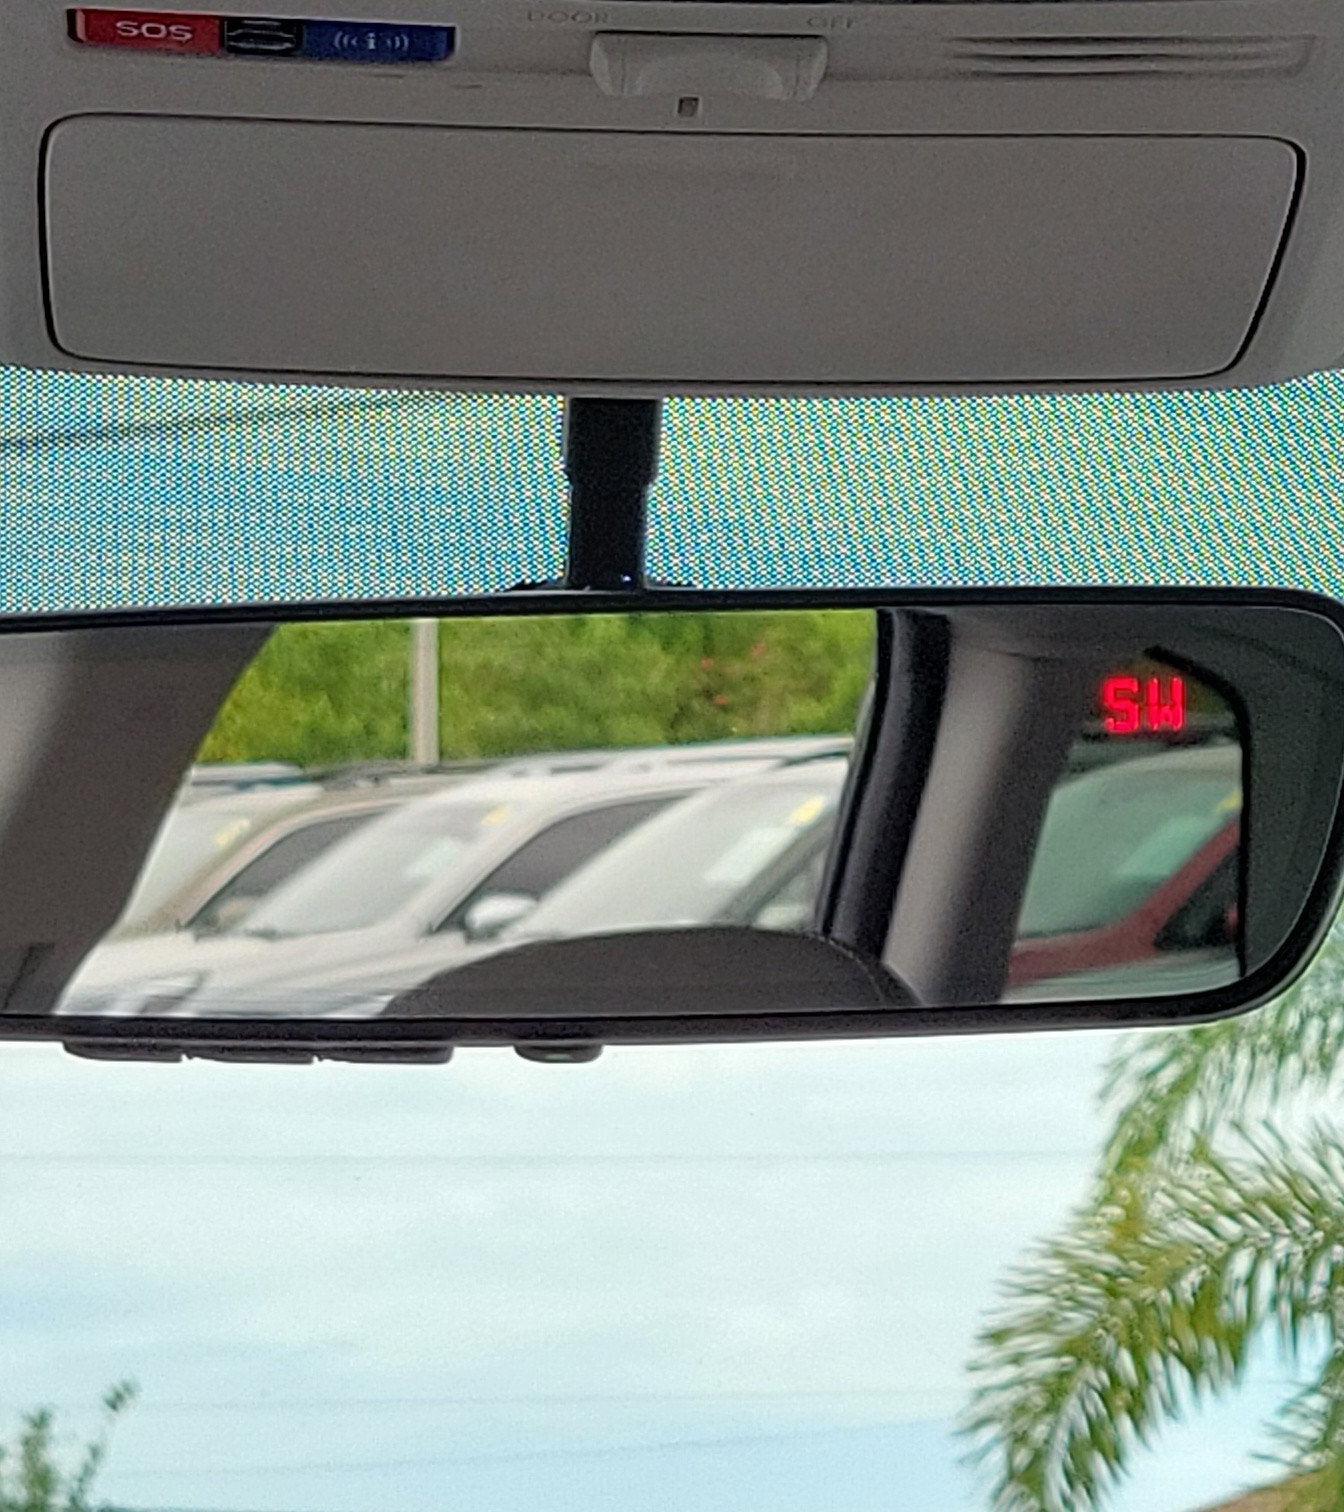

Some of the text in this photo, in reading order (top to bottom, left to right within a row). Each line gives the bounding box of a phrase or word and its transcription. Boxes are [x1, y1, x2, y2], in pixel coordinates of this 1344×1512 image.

[115, 19, 194, 43] SOS
[526, 9, 858, 30] DOOR OFF
[1102, 676, 1188, 735] SW
